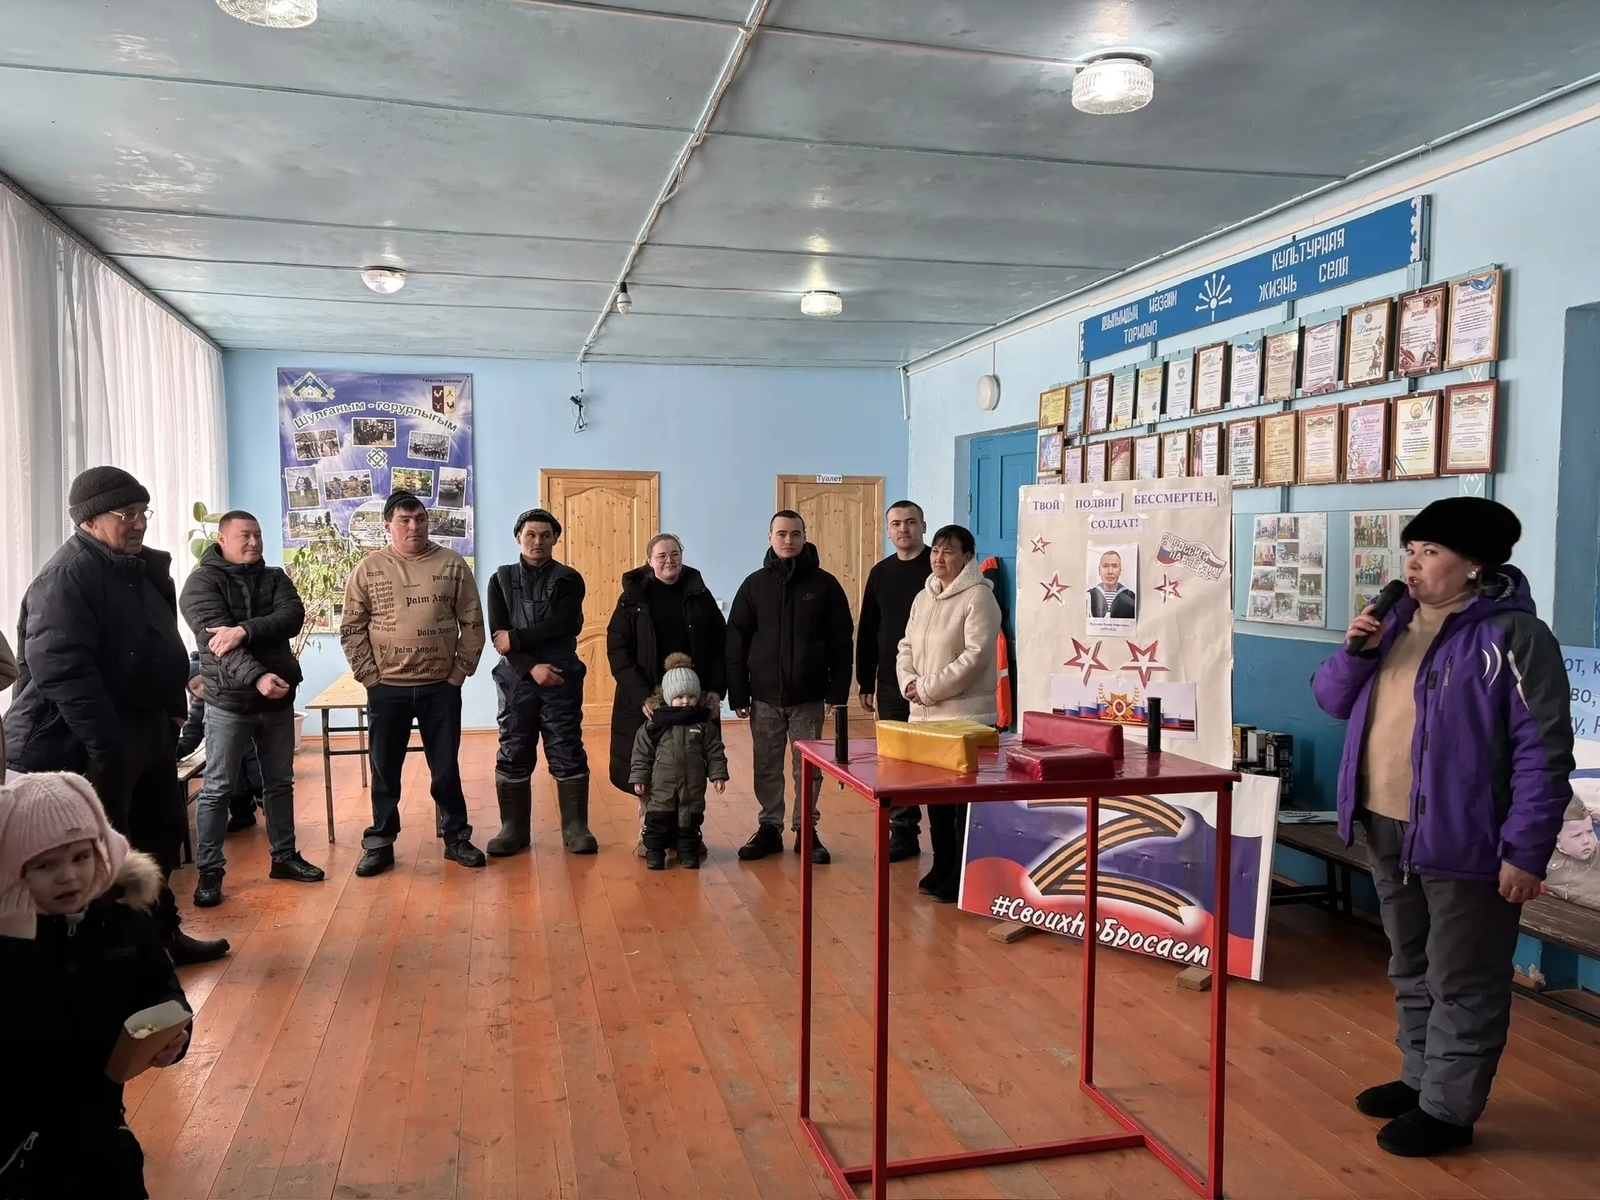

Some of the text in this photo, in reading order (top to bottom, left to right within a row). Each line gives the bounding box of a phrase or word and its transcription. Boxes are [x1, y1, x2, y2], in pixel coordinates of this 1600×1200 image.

[1272, 228, 1345, 272] КУЛЬТУРНАЯ
[1259, 274, 1298, 303] ЖИЗНЬ
[293, 401, 365, 429] Шулғаным
[817, 474, 842, 482] Туалет
[1075, 498, 1119, 509] ПОДВИГ
[1134, 491, 1217, 505] БЕССМЕРТЕН,
[1090, 518, 1139, 530] СОЛДАТ!
[406, 595, 430, 607] Palm
[417, 627, 437, 637] Palm
[394, 644, 439, 655] Palm Angels
[990, 895, 1211, 967] #СвоихНБросаем
